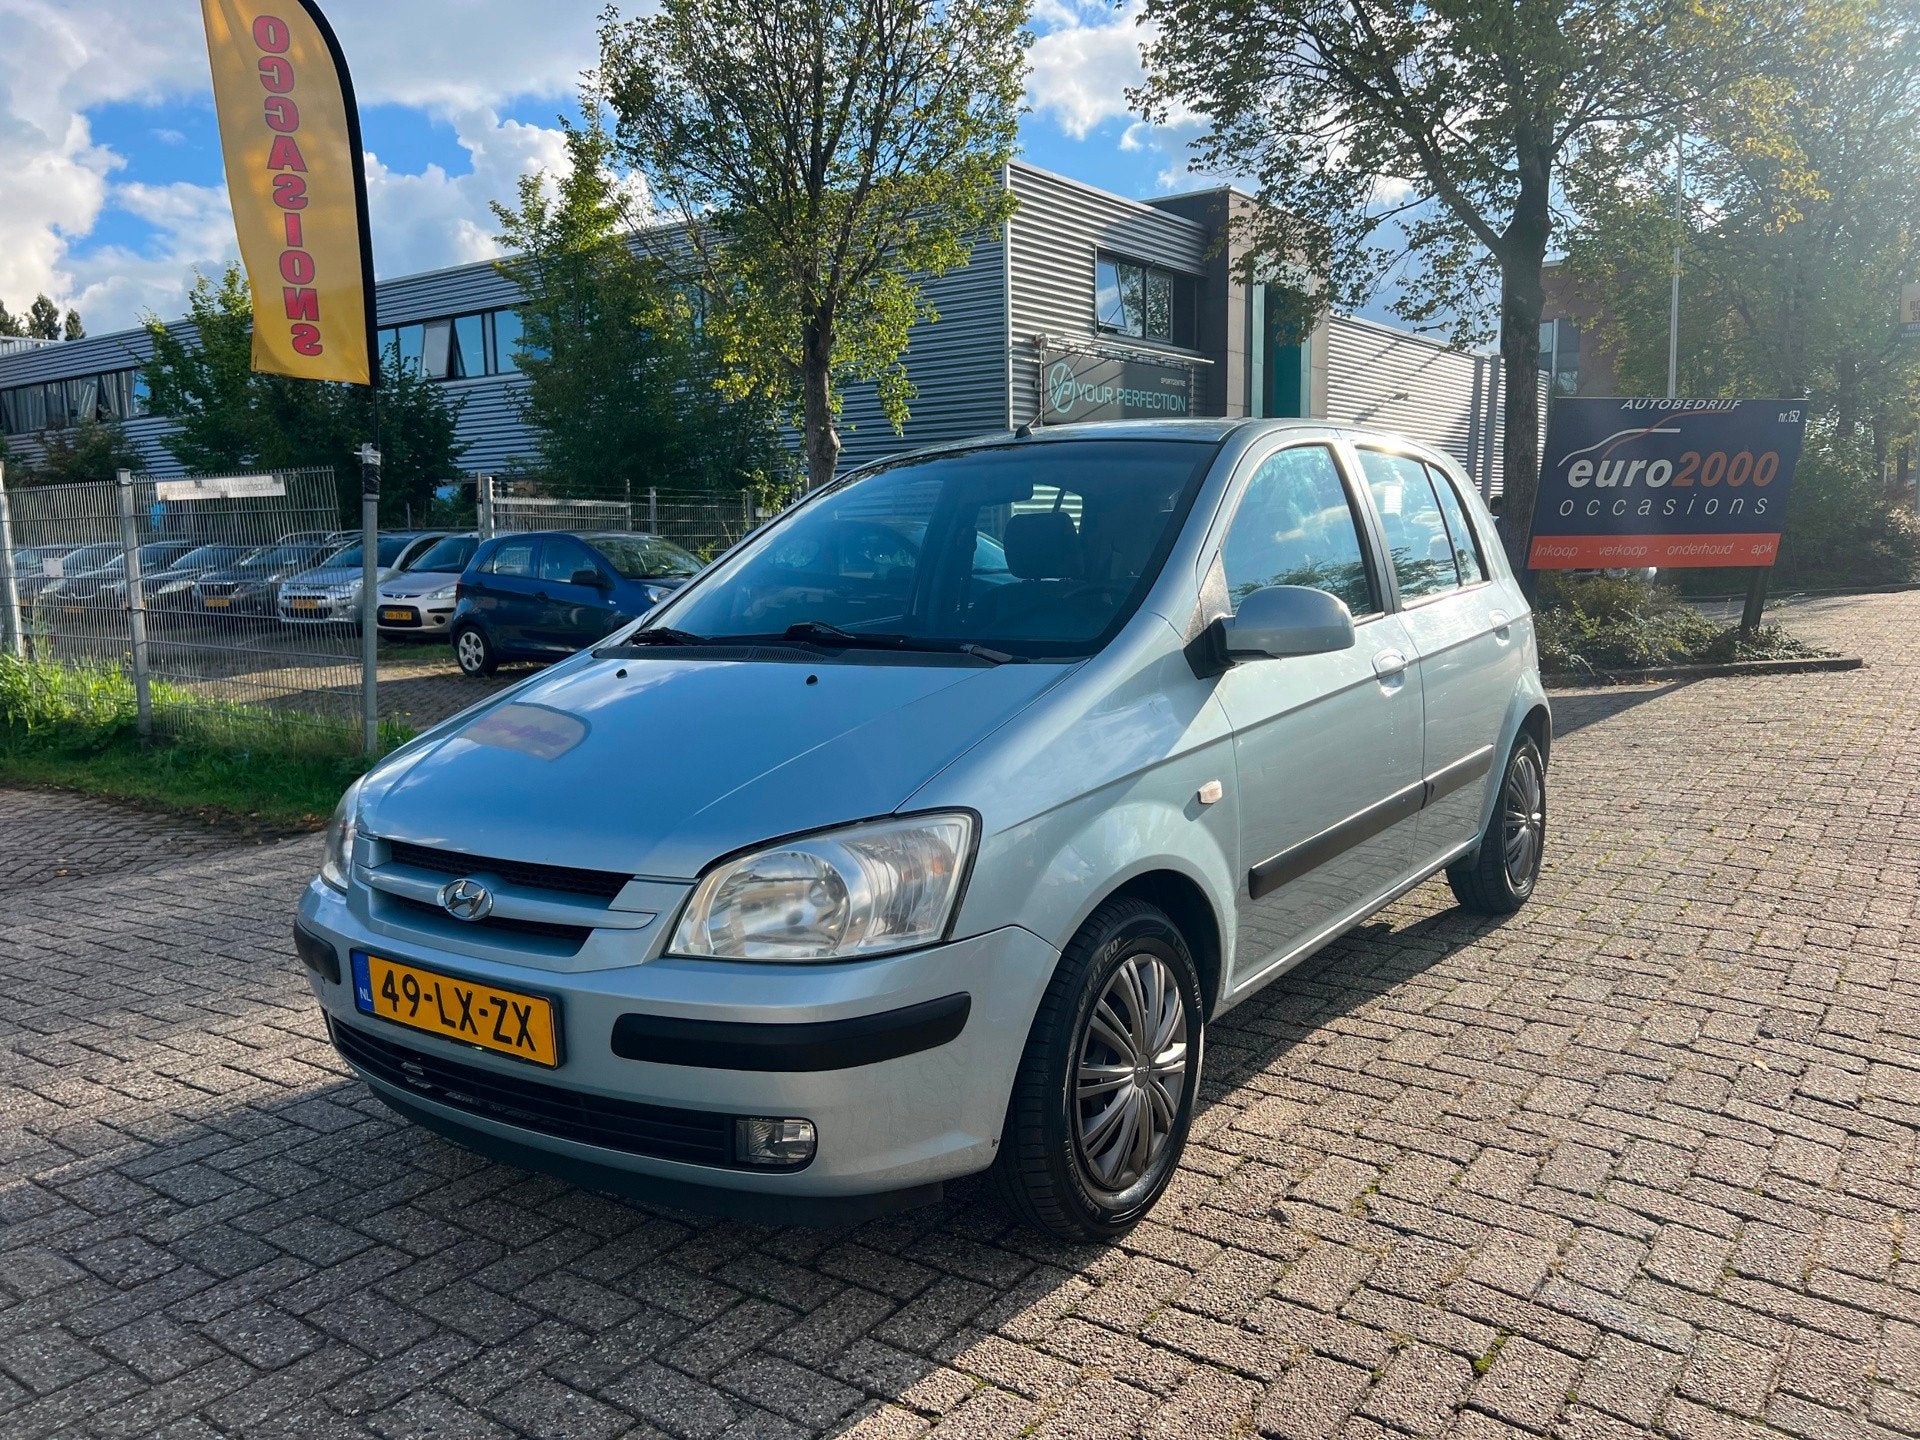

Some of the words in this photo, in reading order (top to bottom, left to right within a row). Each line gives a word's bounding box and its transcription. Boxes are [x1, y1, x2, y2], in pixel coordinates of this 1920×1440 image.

[1077, 383, 1114, 405] YOUR
[1117, 388, 1186, 412] PERFECTION
[1621, 399, 1742, 410] AUTOBEDRIJF
[1778, 410, 1801, 423] nr.152
[1567, 451, 1780, 488] euro2000
[1559, 494, 1768, 516] occasions
[1535, 544, 1578, 559] Inkoop
[1599, 544, 1647, 558] verkoop
[1667, 542, 1735, 555] onderhoud
[1750, 541, 1774, 556] apk
[359, 987, 372, 1002] NL
[381, 969, 537, 1052] 49-LX-ZX
